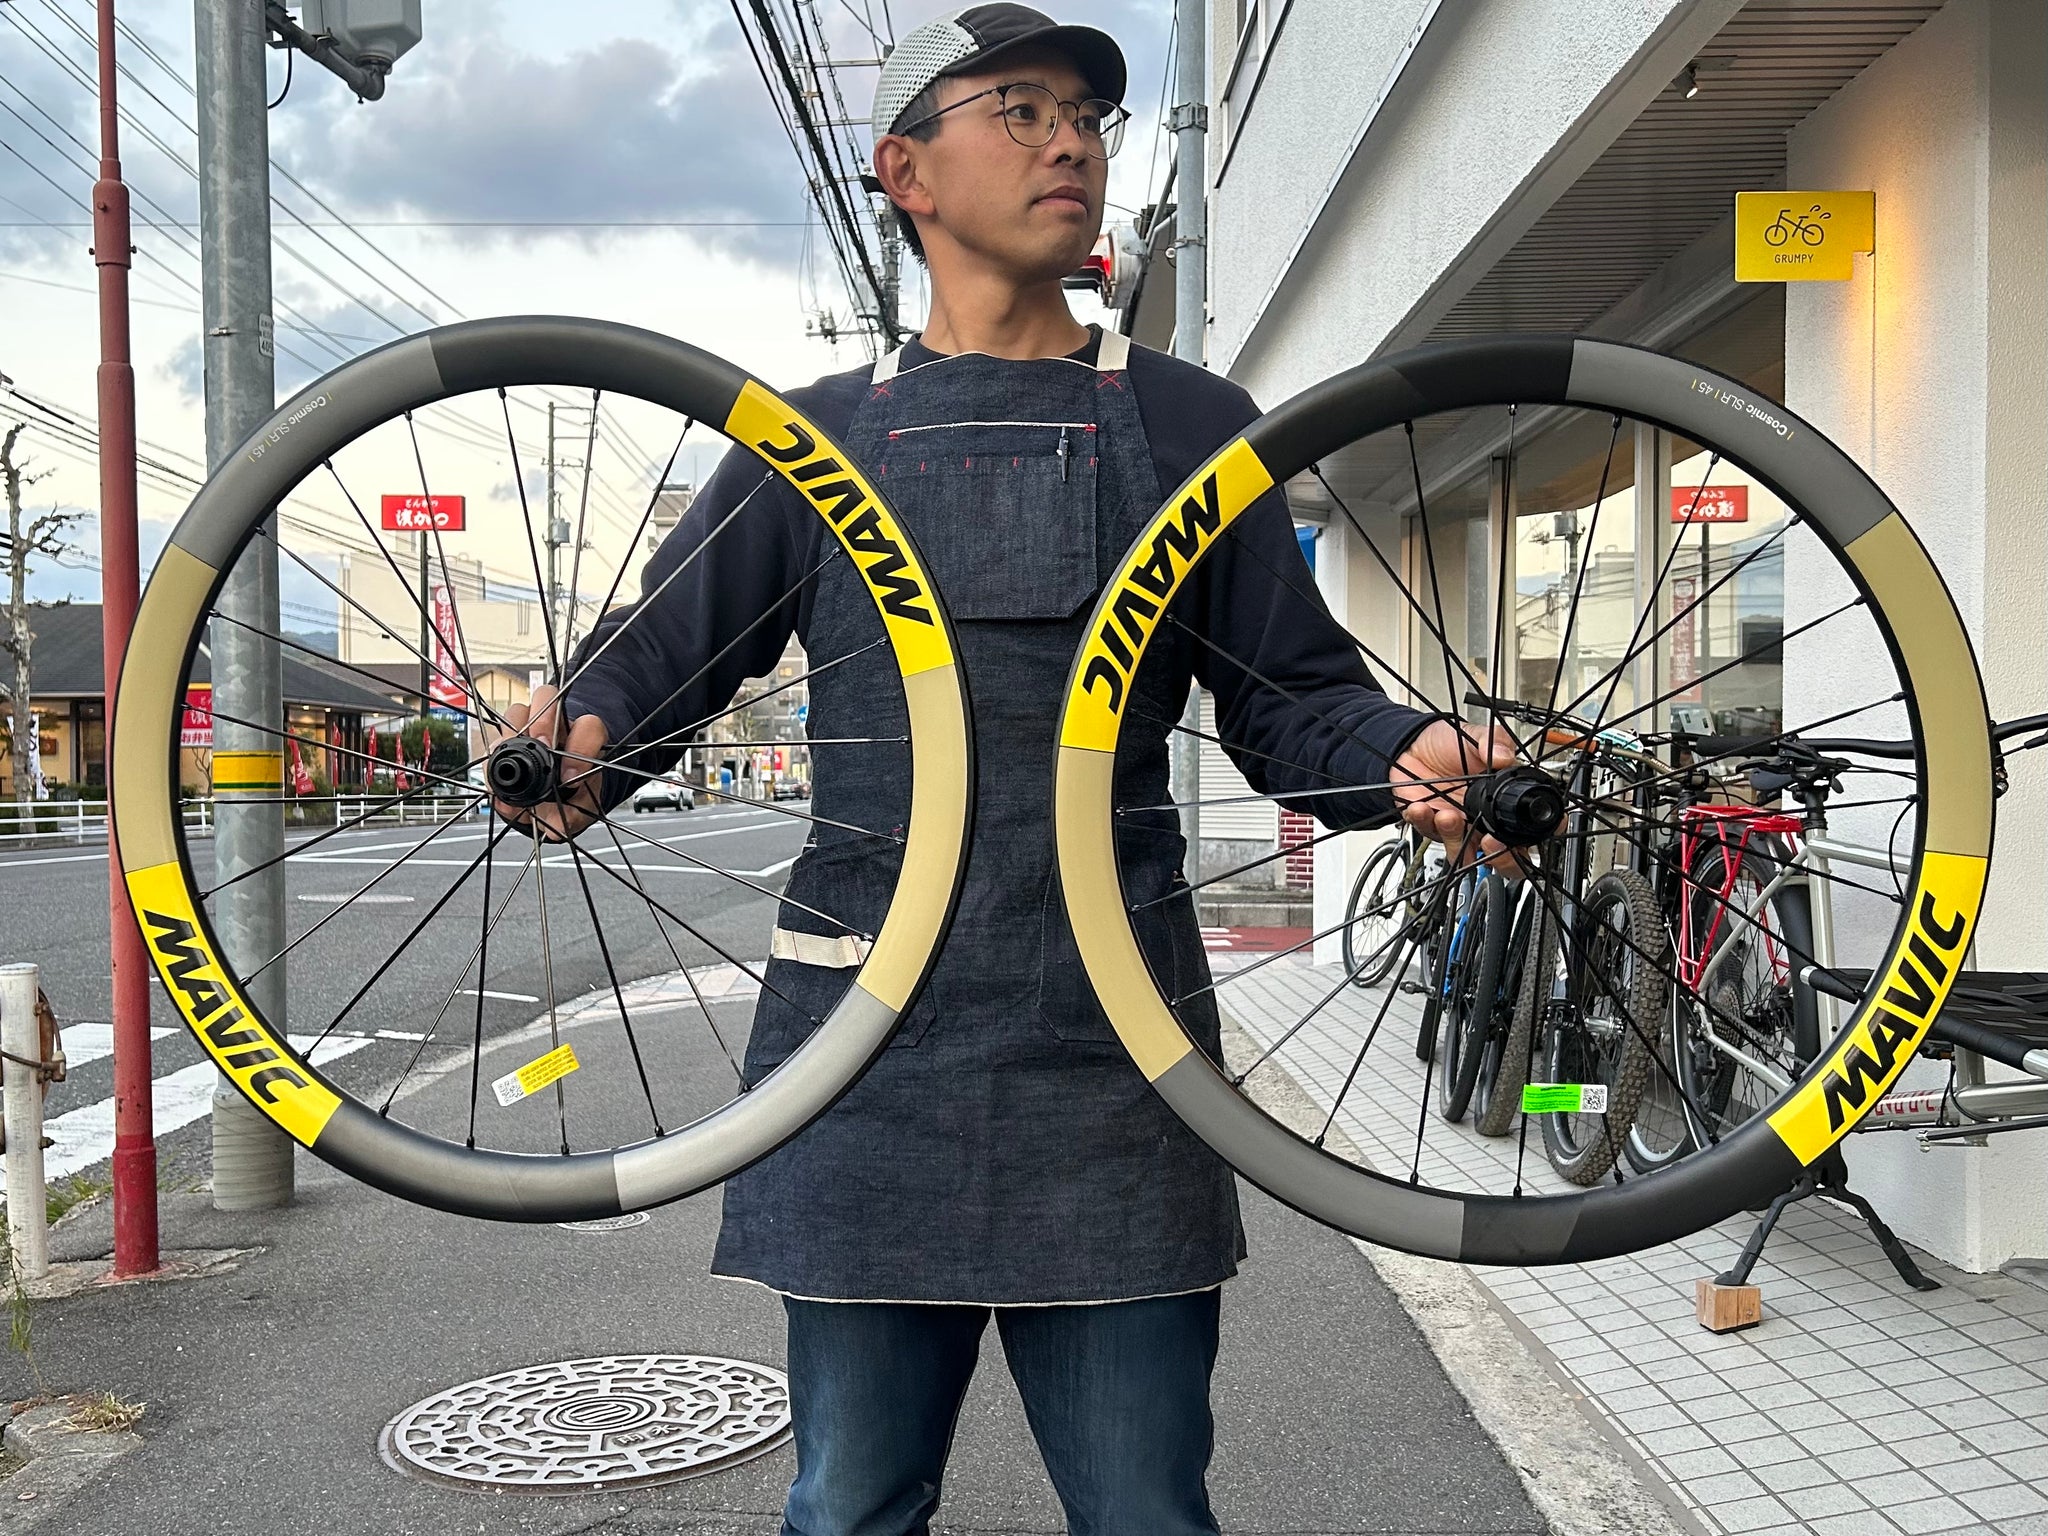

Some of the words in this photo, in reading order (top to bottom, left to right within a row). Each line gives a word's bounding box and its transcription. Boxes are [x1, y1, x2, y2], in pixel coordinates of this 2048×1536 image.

[1774, 254, 1815, 264] GRUMPY
[1697, 381, 1714, 395] 45
[1720, 391, 1745, 410] SLR
[288, 396, 326, 425] Cosmic
[1746, 404, 1788, 436] Cosmic
[268, 422, 290, 442] SLR
[252, 444, 265, 458] 45
[756, 421, 935, 627] MAVIC
[1081, 470, 1222, 716] MAVIC
[142, 908, 310, 1105] MAVIC
[1821, 889, 1967, 1135] MAVIC
